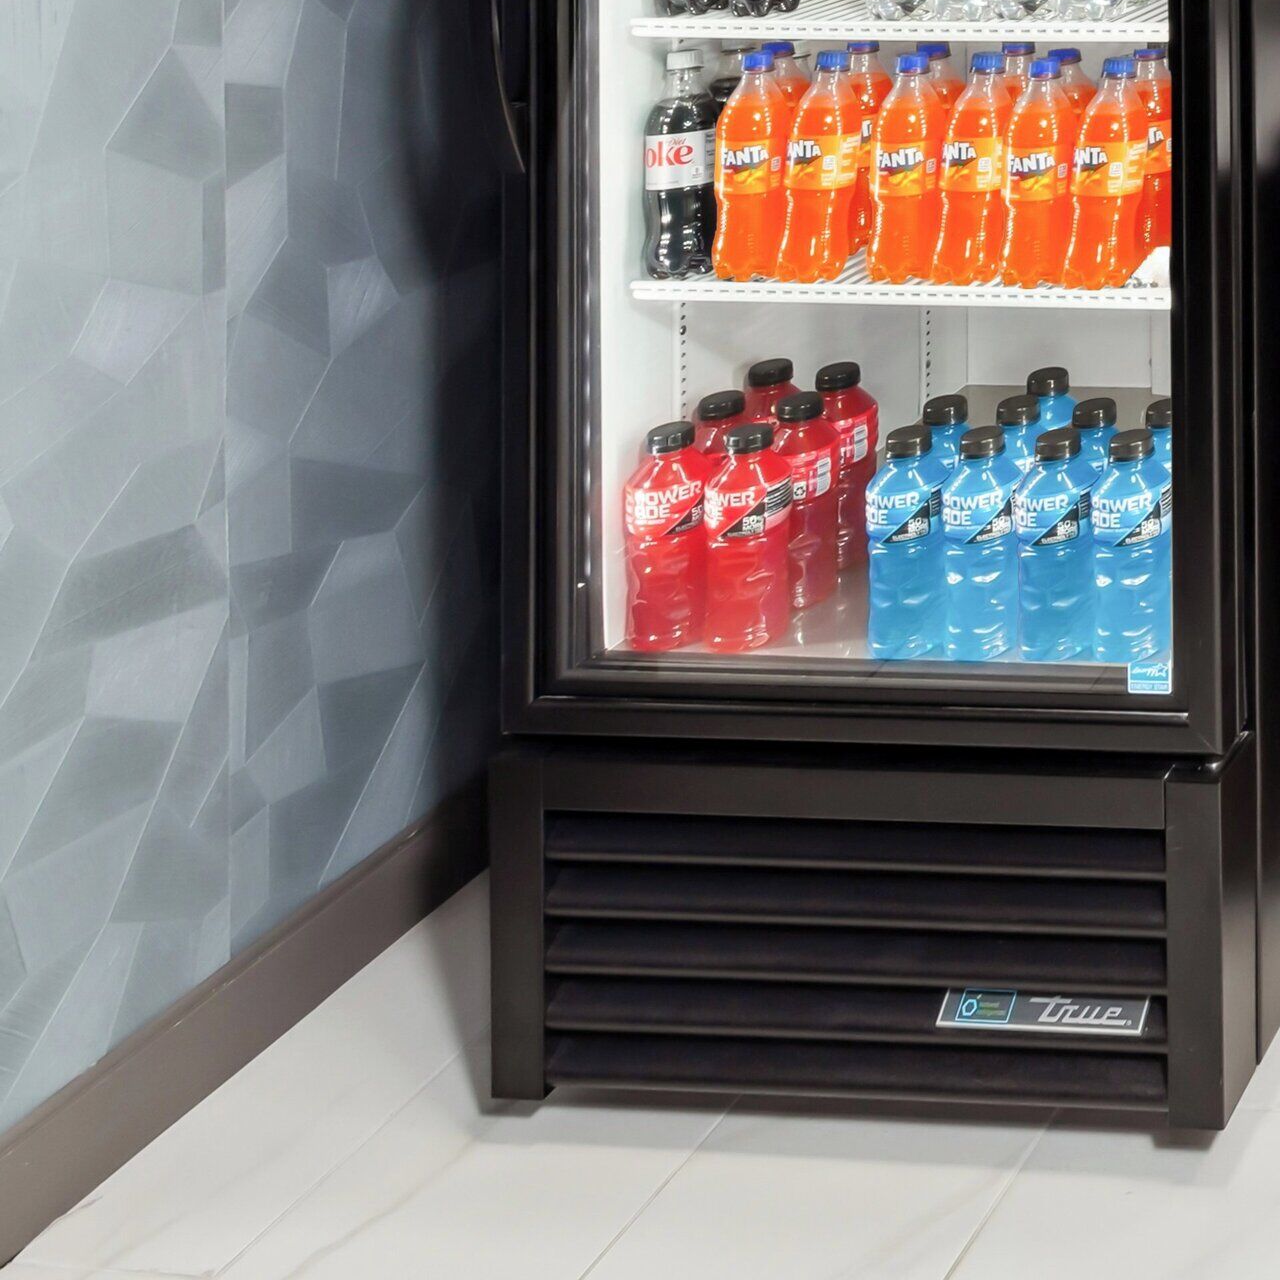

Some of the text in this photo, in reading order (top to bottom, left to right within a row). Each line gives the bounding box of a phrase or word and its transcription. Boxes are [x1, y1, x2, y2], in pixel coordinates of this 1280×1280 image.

[646, 141, 694, 169] oke
[721, 145, 770, 166] FANTA
[876, 147, 924, 169] FANTA
[1008, 152, 1056, 172] FANTA
